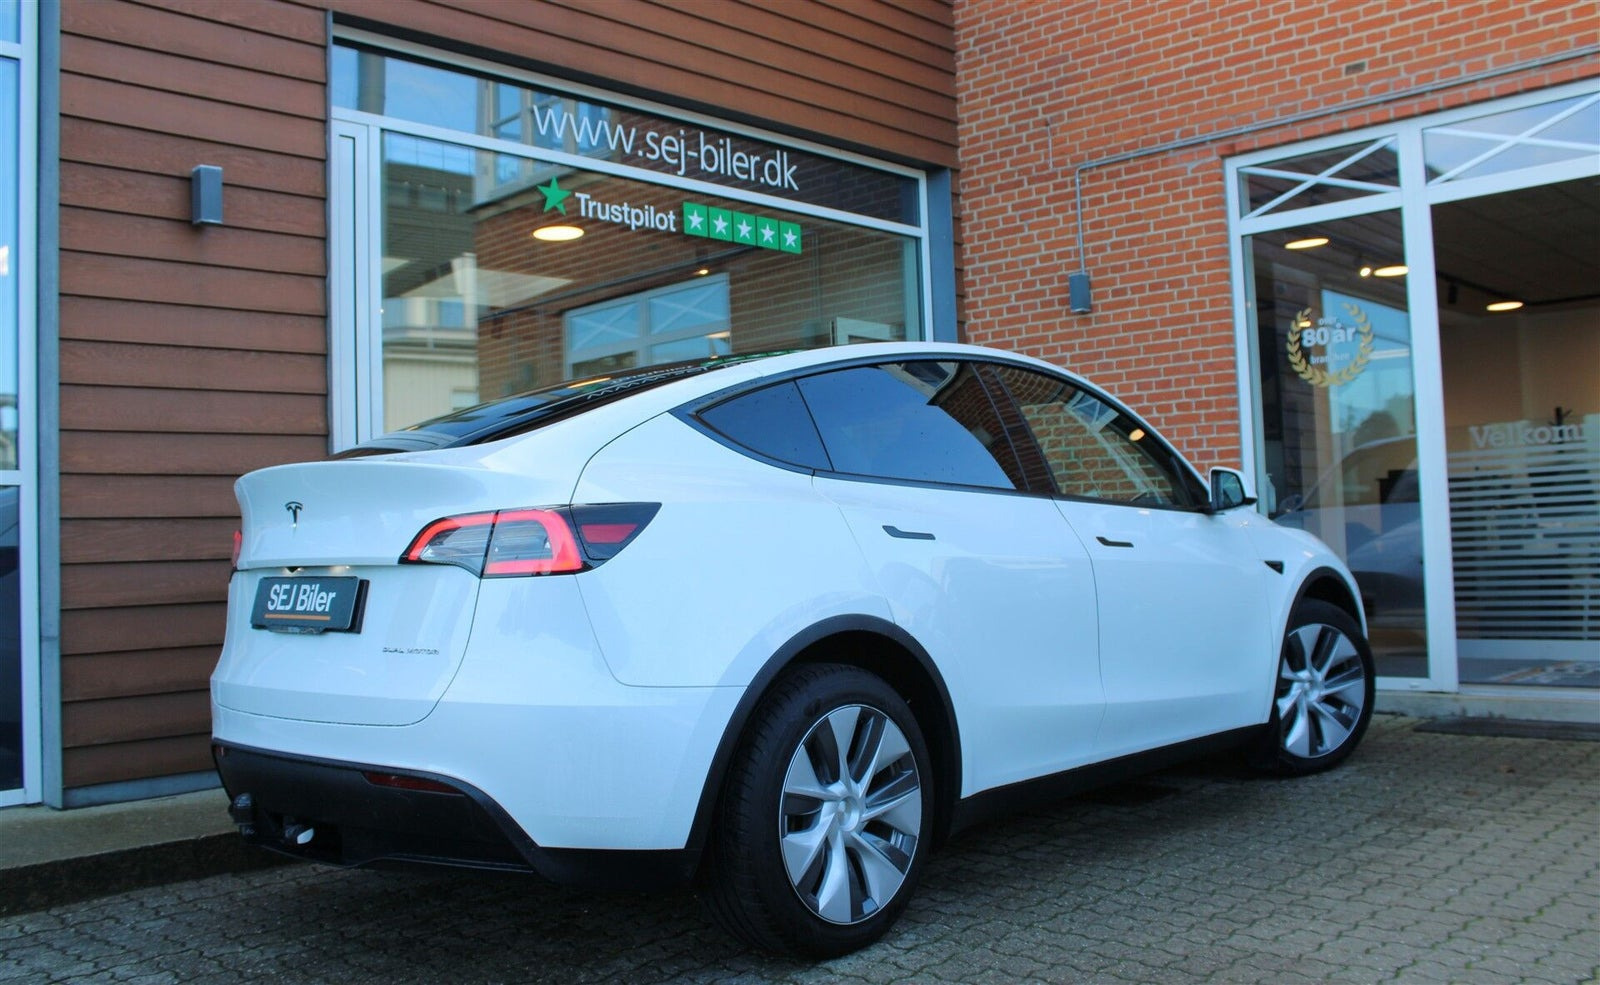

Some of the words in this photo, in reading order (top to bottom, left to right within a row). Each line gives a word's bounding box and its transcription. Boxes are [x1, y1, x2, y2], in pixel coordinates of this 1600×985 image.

[533, 105, 799, 191] www.sej-biler.dk
[575, 192, 676, 232] Trustpilot
[1302, 327, 1329, 347] 80
[1331, 323, 1356, 343] år
[267, 584, 297, 611] SEJ
[296, 584, 336, 612] Biler
